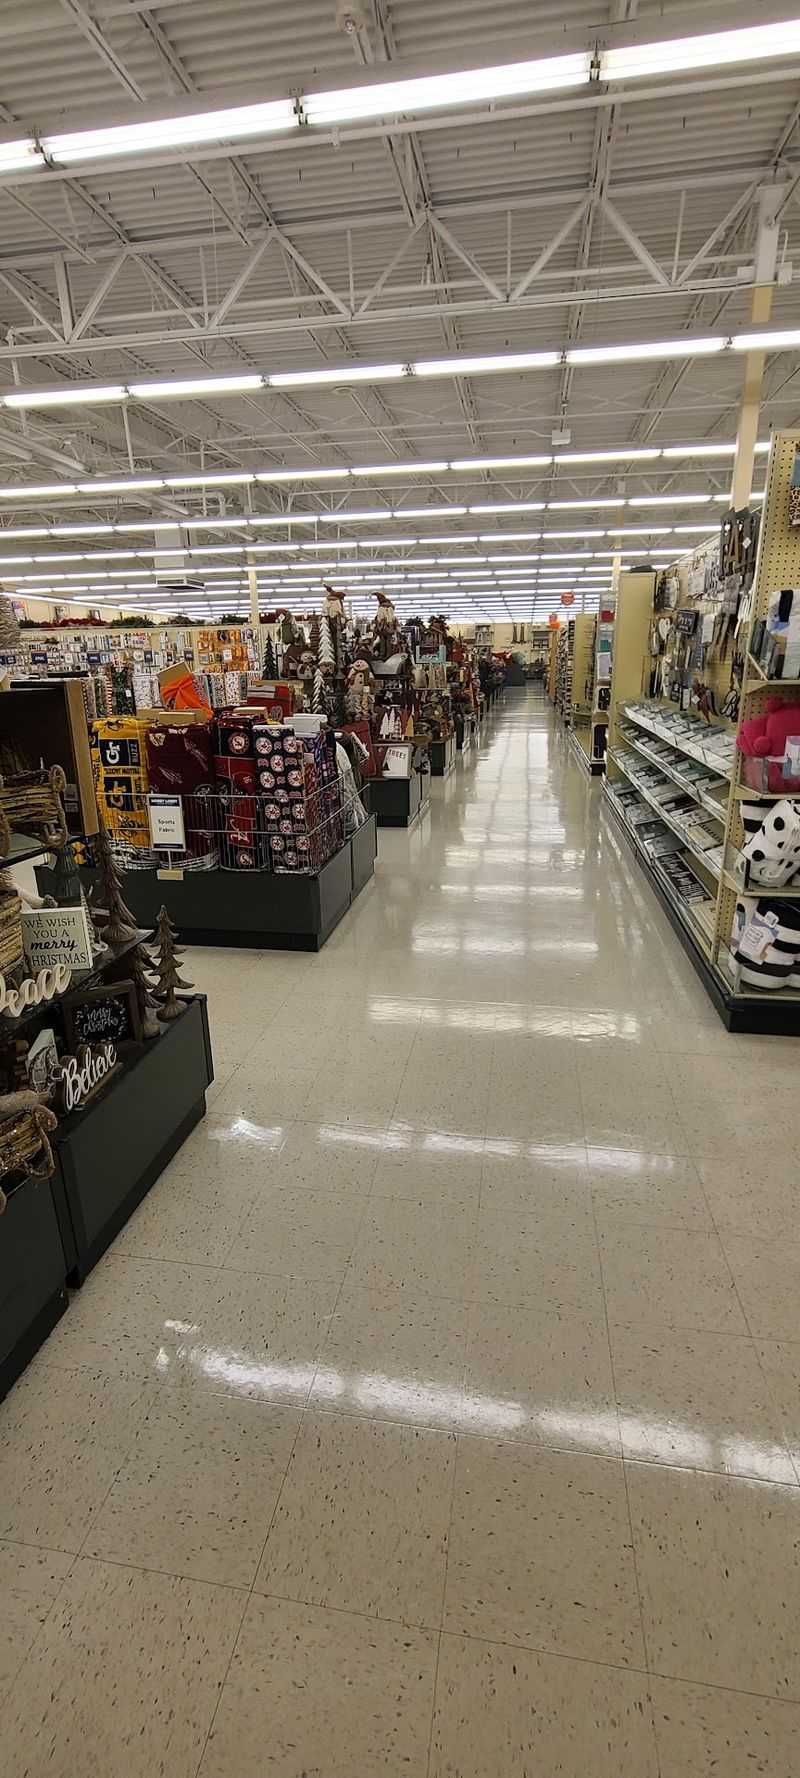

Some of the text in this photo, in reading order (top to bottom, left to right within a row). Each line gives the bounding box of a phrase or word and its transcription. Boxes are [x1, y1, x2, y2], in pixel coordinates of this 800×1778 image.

[24, 917, 76, 928] WE WISH
[33, 928, 70, 938] YOU A
[30, 939, 78, 952] merry
[31, 952, 87, 967] HRISTMAS
[61, 1044, 117, 1111] Believe
